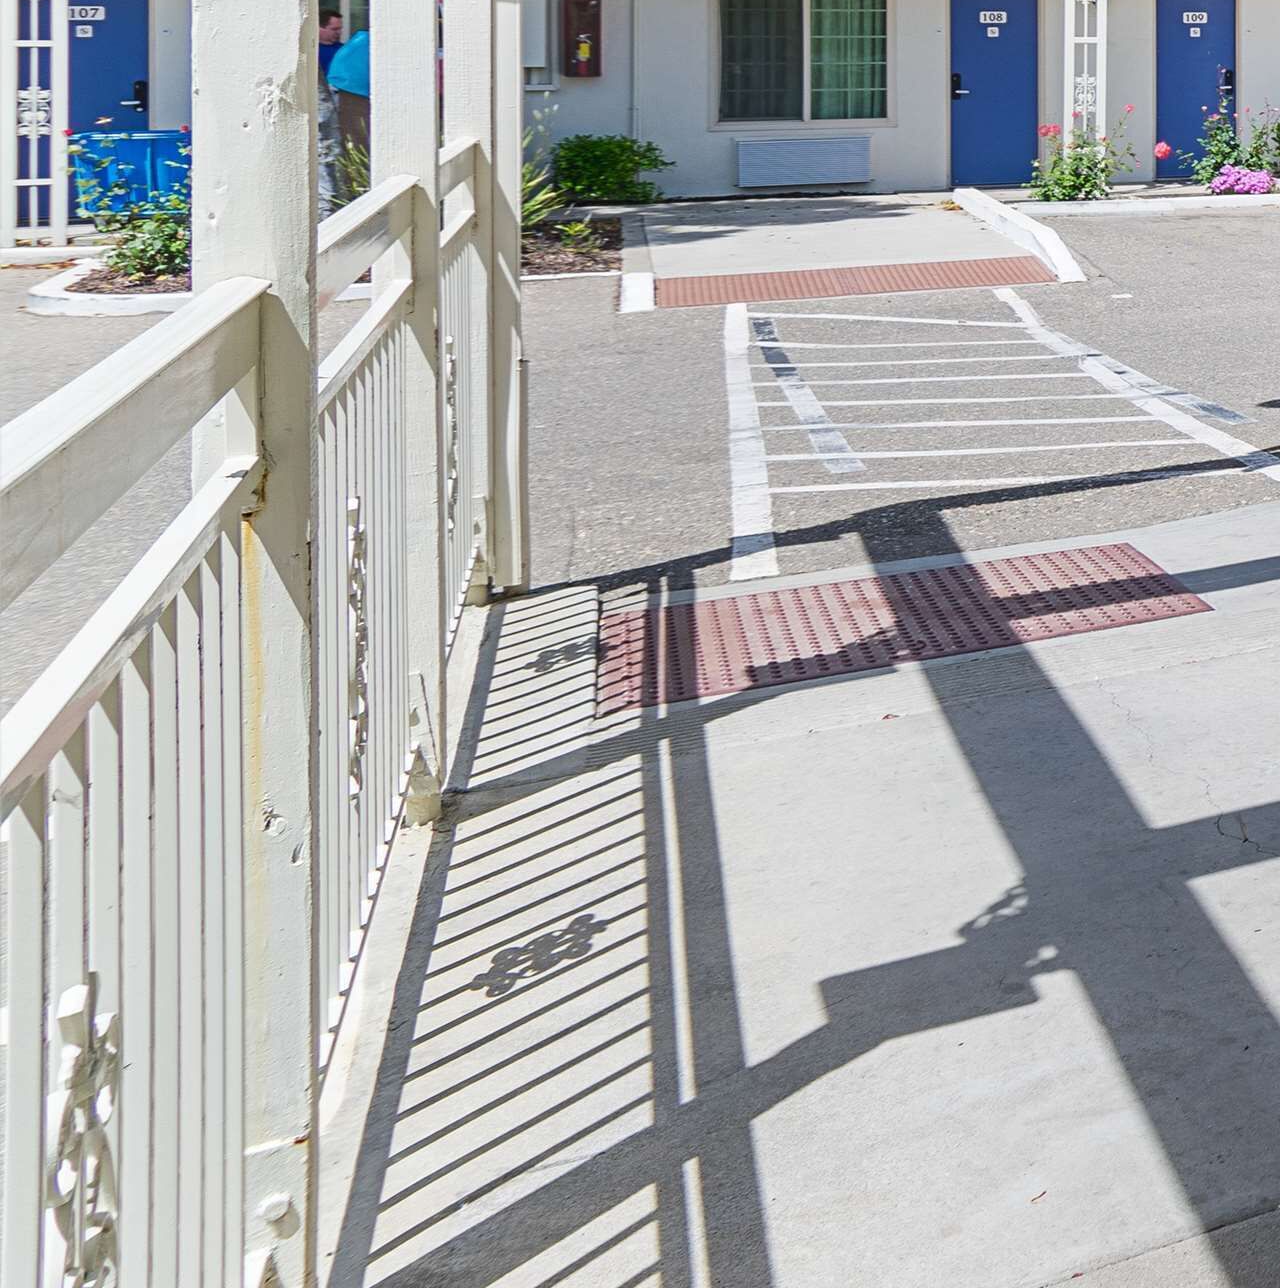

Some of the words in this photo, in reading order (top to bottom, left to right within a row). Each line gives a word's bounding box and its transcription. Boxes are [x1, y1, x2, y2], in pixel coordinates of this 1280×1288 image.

[70, 7, 100, 19] 107
[982, 12, 1004, 22] 108
[1185, 13, 1205, 23] 109
